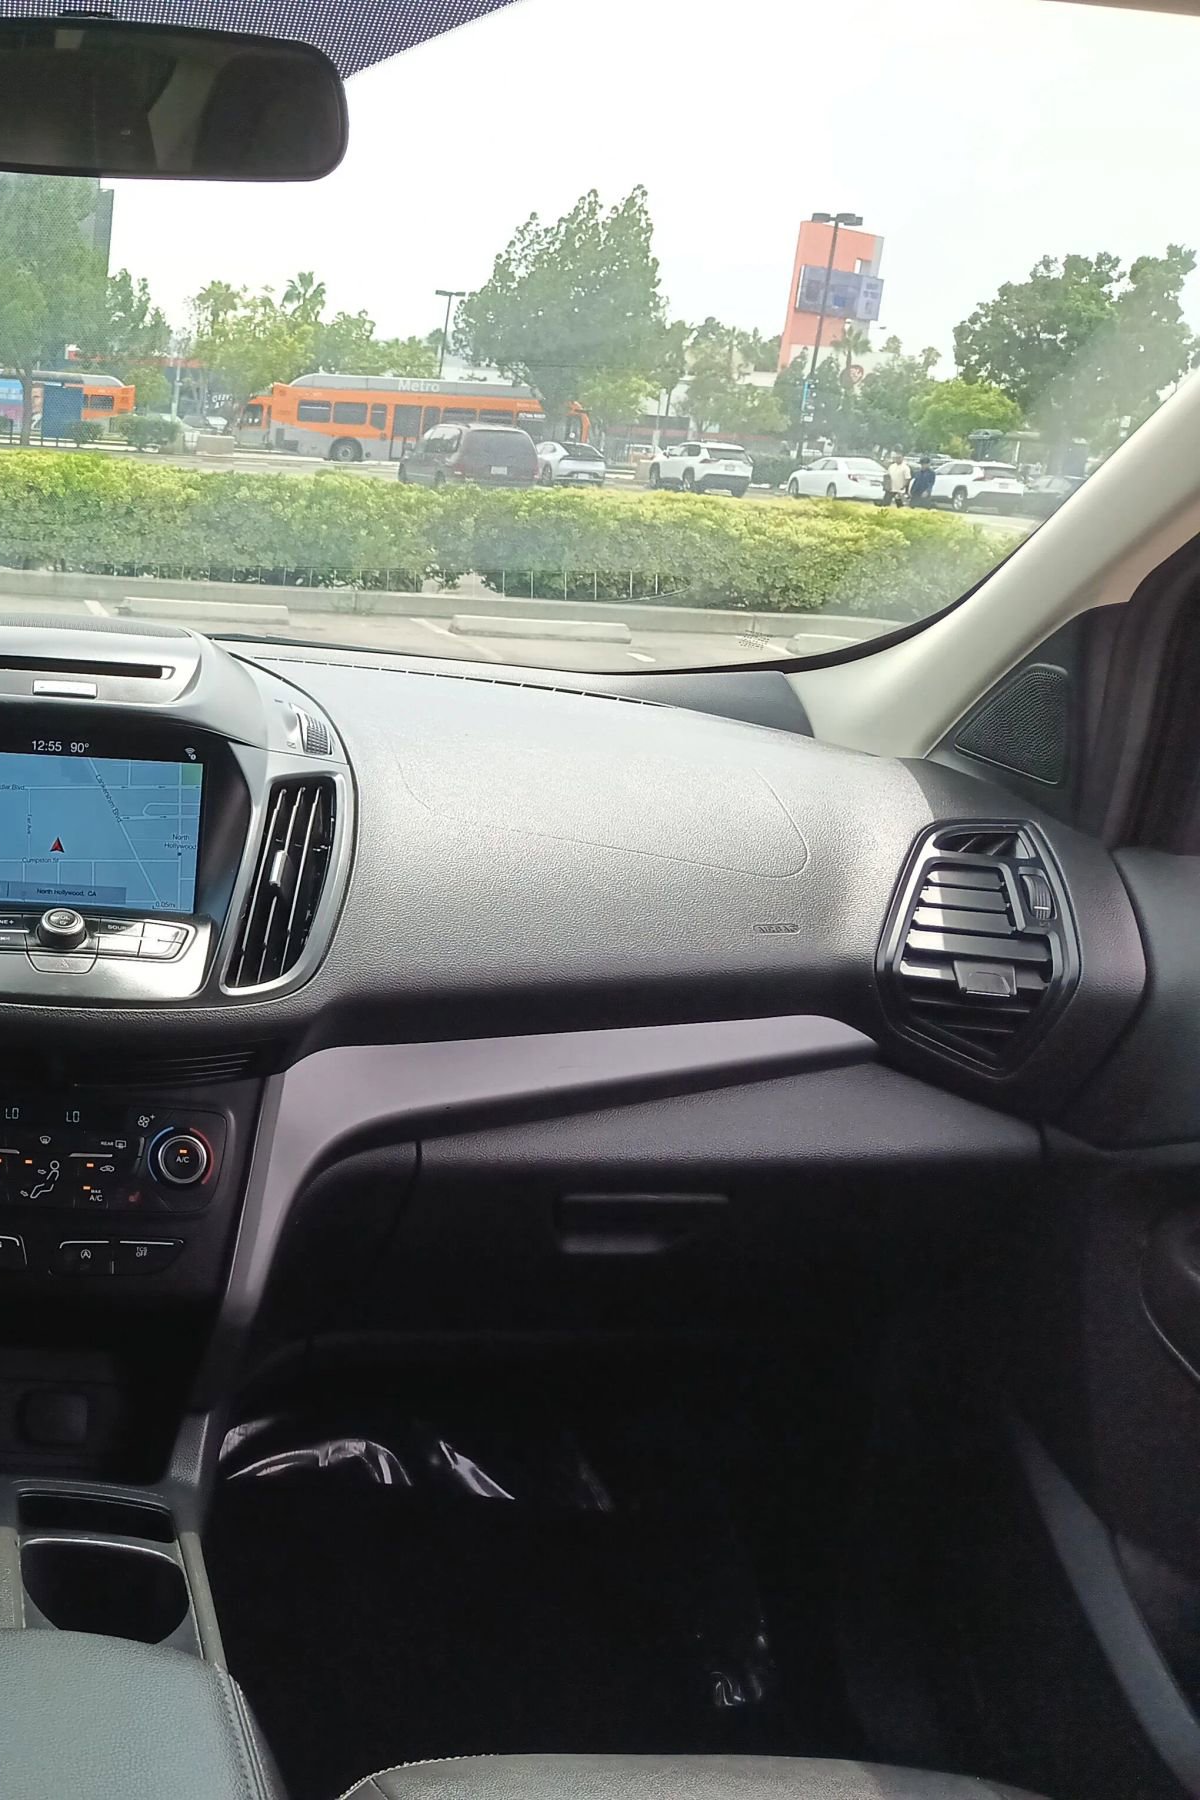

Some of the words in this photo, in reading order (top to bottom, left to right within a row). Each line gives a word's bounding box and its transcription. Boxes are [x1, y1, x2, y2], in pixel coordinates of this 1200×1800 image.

[398, 379, 440, 392] Metro
[31, 740, 62, 752] 12:55
[70, 741, 89, 753] 90°
[164, 842, 197, 851] Hollywood
[36, 887, 53, 895] North
[175, 1155, 190, 1164] A/C
[89, 1194, 103, 1202] A/C
